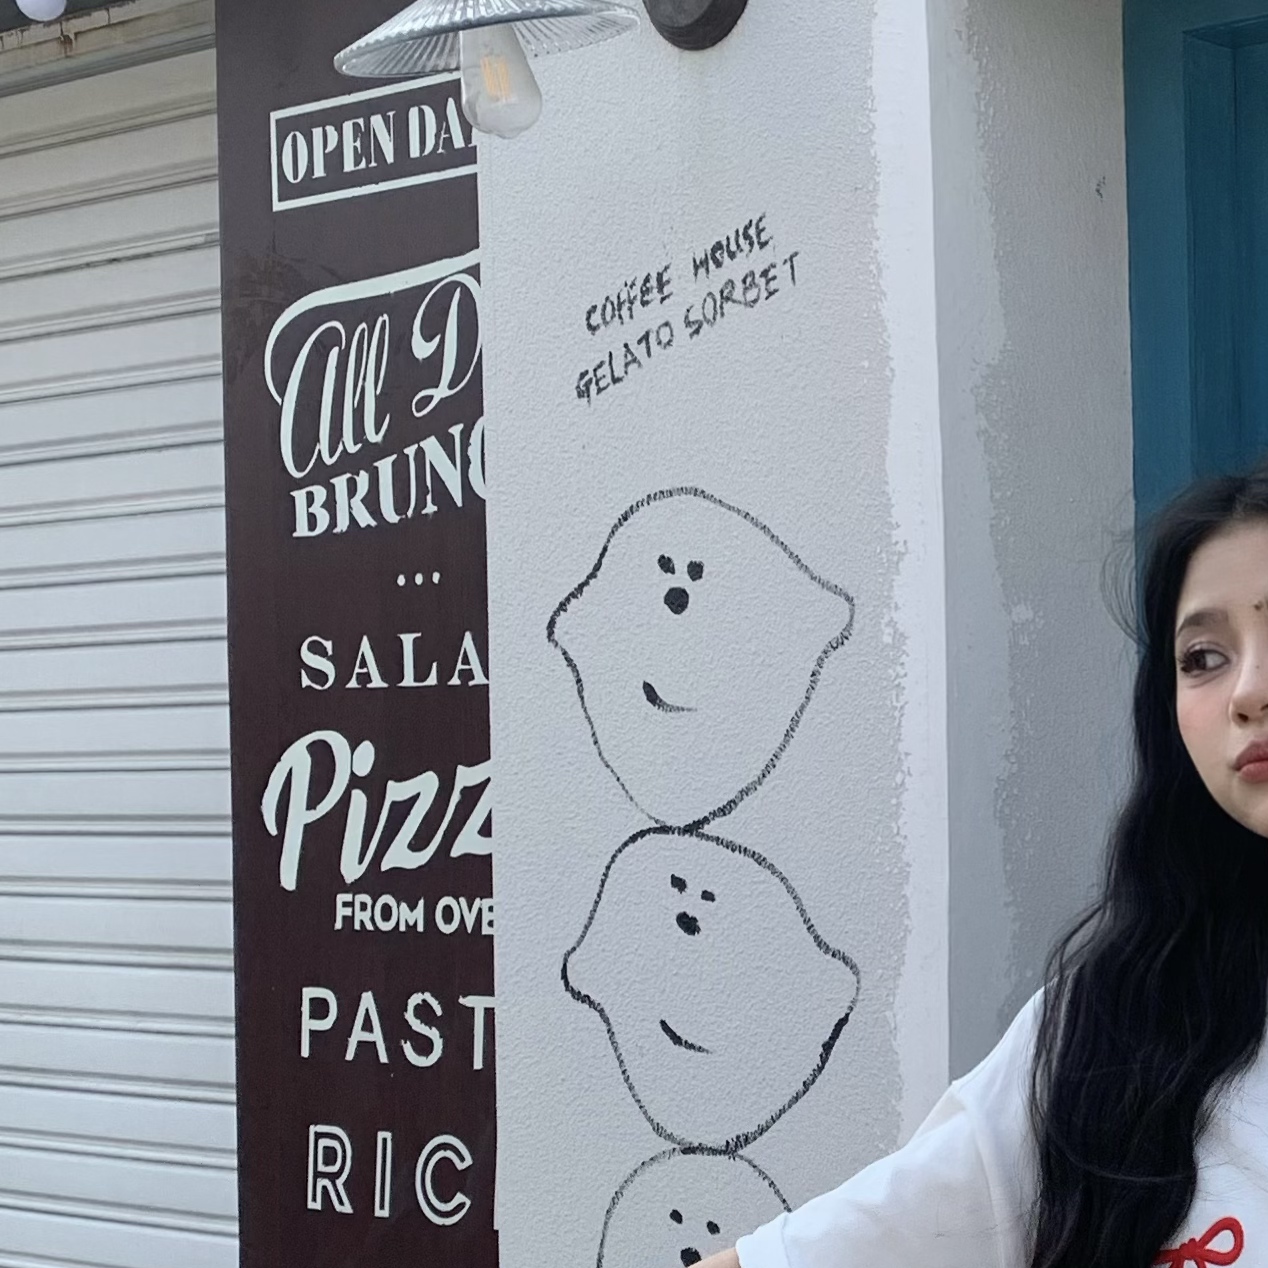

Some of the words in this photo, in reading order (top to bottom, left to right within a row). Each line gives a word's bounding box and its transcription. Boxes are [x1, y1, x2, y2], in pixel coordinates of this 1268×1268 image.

[282, 111, 396, 184] OPEN
[408, 97, 477, 159] DA
[585, 263, 673, 336] COFFEE
[692, 212, 774, 283] HOUSE
[575, 321, 674, 407] GELATO
[684, 251, 799, 339] SORBET
[280, 313, 390, 478] All
[300, 630, 490, 690] SALA
[261, 730, 493, 891] Pizz
[334, 893, 425, 932] FROM
[300, 986, 496, 1070] PAST
[307, 1124, 474, 1226] RIC
